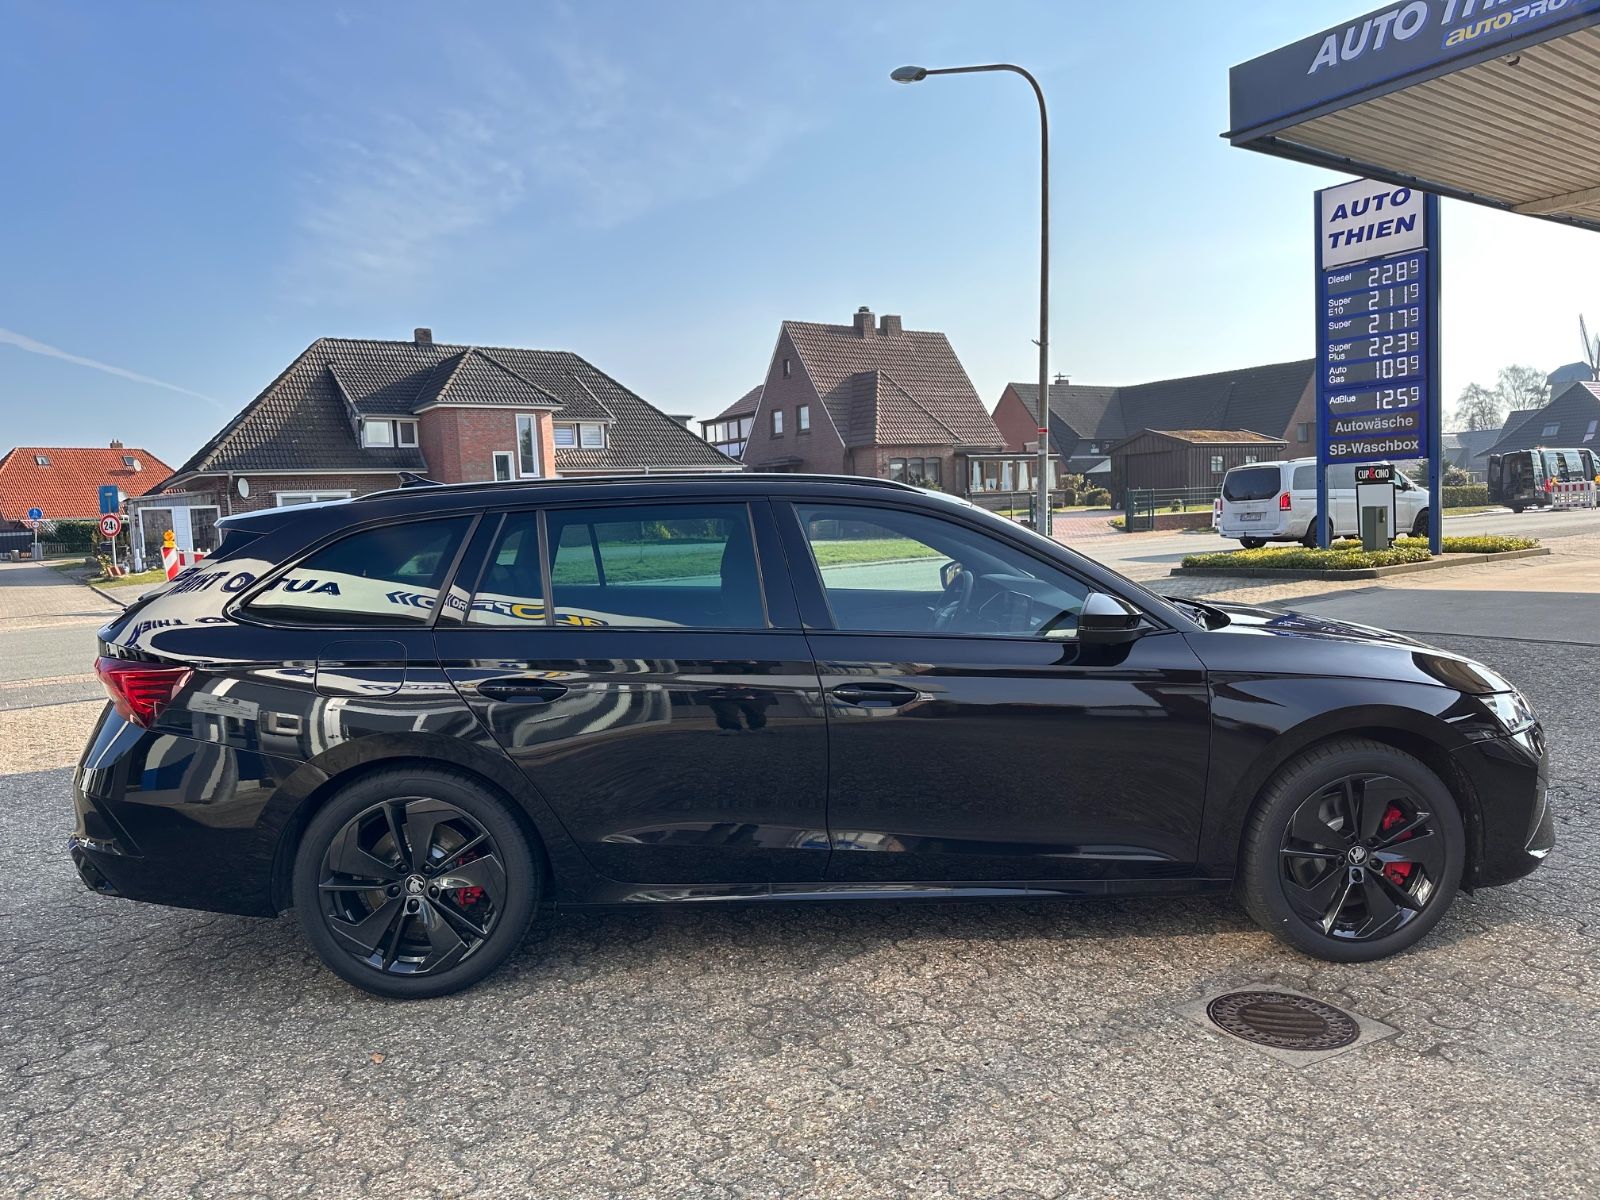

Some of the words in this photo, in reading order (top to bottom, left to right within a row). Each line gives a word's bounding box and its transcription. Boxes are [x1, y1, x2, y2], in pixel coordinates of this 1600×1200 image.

[1307, 1, 1428, 75] AUTO
[1330, 187, 1411, 223] AUTO
[1328, 213, 1417, 249] THIEN
[1328, 273, 1352, 285] Diesel
[1328, 297, 1352, 307] Super
[1328, 307, 1344, 316] E10
[1328, 320, 1352, 330] Super
[1328, 343, 1352, 353] Super
[1328, 353, 1346, 361] Plus
[1329, 366, 1348, 375] Auto
[1329, 375, 1345, 384] Gas
[1329, 395, 1356, 405] AdBlue
[1334, 415, 1414, 433] Autowäsche
[1329, 439, 1419, 456] SB-Waschbox
